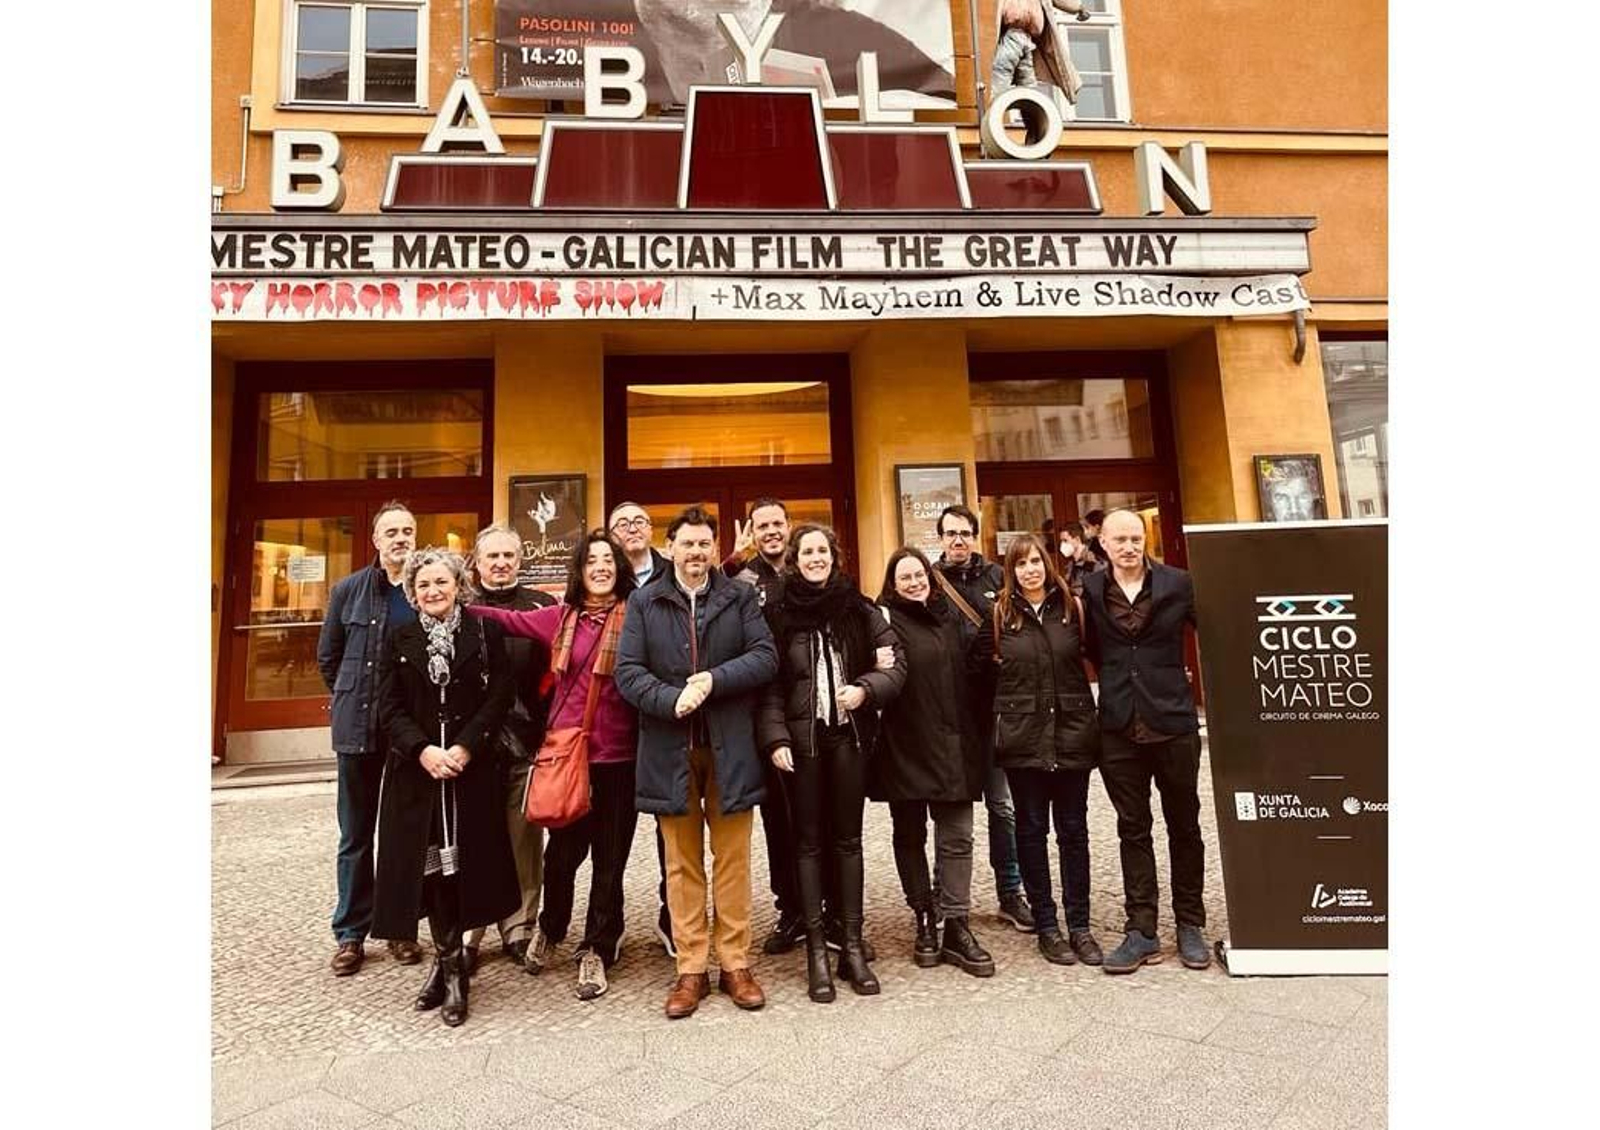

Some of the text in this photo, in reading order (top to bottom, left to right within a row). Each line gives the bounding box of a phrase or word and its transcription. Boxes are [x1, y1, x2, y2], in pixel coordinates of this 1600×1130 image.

[519, 17, 634, 35] PASOLINI 100!
[520, 47, 583, 65] 14.-20.
[211, 234, 374, 269] MESTRE
[393, 235, 530, 269] MATEO
[562, 235, 736, 269] GALICIAN
[751, 236, 843, 268] FILM
[876, 236, 944, 267] THE
[964, 235, 1081, 267] GREAT
[1103, 235, 1178, 267] WAY
[266, 282, 403, 318] HORROR
[416, 281, 562, 317] PICTURE
[574, 280, 666, 316] SHOW
[819, 286, 963, 316] Mayhem
[977, 281, 1003, 307] &
[1015, 281, 1080, 306] Live
[1094, 281, 1220, 308] Shadow
[1231, 283, 1311, 307] Cast
[1260, 626, 1357, 650] CICLO
[1253, 653, 1373, 679] MESTRE
[1260, 682, 1372, 708] MATEO
[1260, 711, 1380, 720] CIRCUITO DE CINEMA GALEGO
[1258, 794, 1302, 806] XUNTA
[1259, 807, 1330, 818] DE GALICIA
